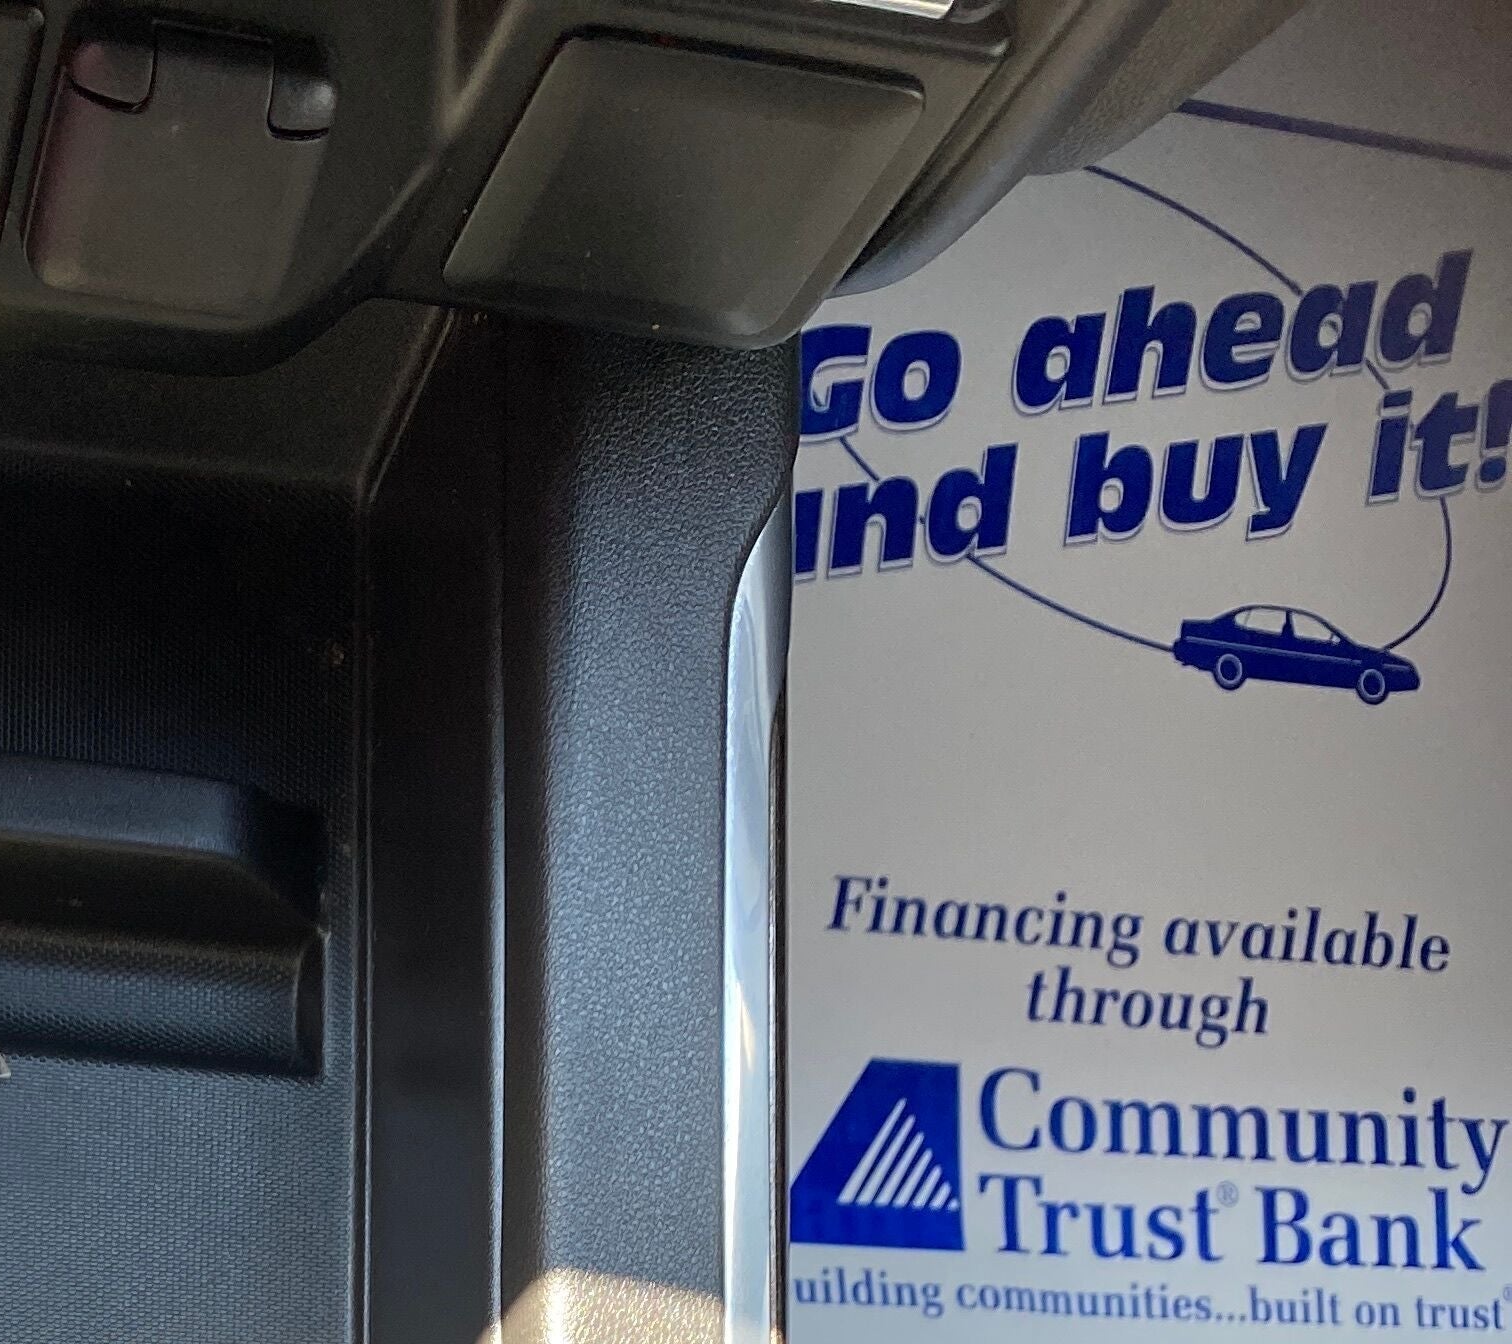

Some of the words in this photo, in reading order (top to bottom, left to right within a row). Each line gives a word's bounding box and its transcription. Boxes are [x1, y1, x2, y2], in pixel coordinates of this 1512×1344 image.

[799, 323, 962, 438] Go
[1011, 248, 1474, 416] ahead
[1064, 421, 1329, 547] buy
[1365, 378, 1512, 507] it!
[826, 875, 1144, 969] Financing
[1164, 907, 1451, 974] available
[1026, 967, 1269, 1048] through
[978, 1067, 1509, 1195] Community
[1255, 1187, 1487, 1272] Bank
[793, 1267, 945, 1319] uilding
[1355, 1300, 1402, 1327] on
